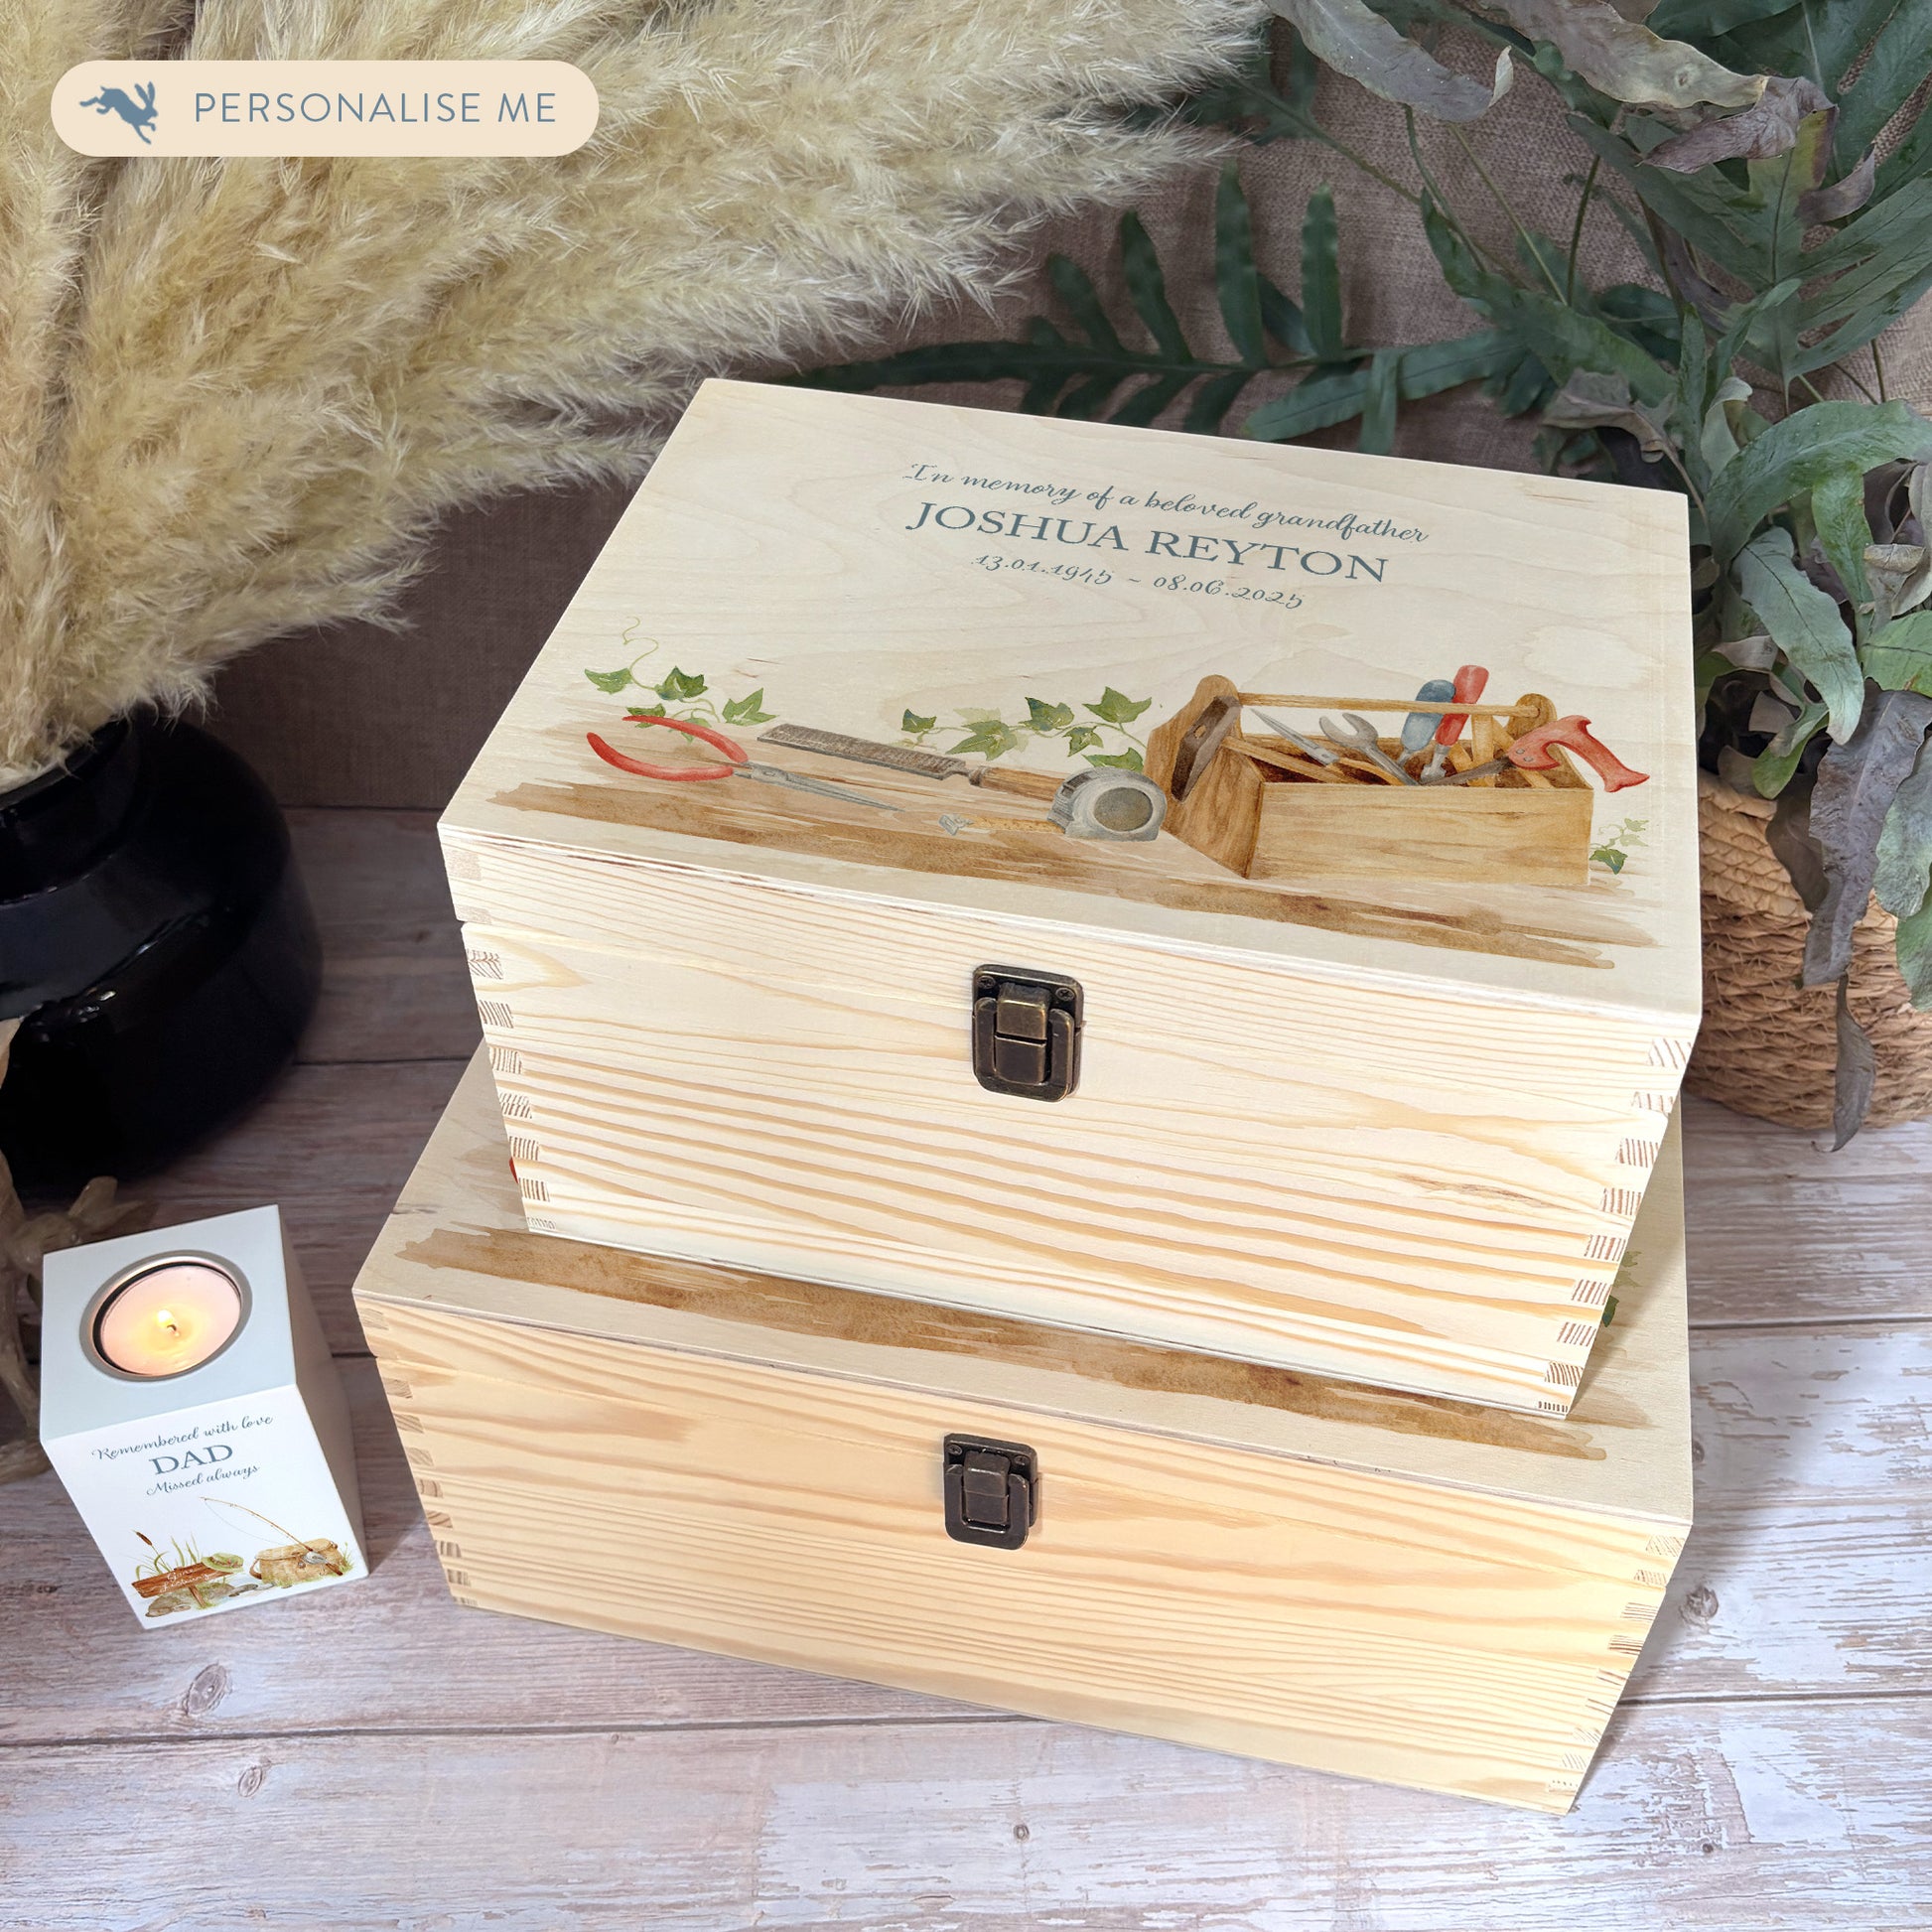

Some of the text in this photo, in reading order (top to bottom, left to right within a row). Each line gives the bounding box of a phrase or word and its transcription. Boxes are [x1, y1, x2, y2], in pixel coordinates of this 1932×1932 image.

[904, 463, 1429, 544] In memory of a beloved grandfather
[905, 501, 1388, 584] JOSHUA REYTON
[971, 554, 1114, 586] 13.01.1945
[1153, 573, 1304, 609] 08.06.2025
[92, 1415, 274, 1460] Remembered with love
[149, 1444, 234, 1475] DAD
[146, 1463, 260, 1496] Missed always
